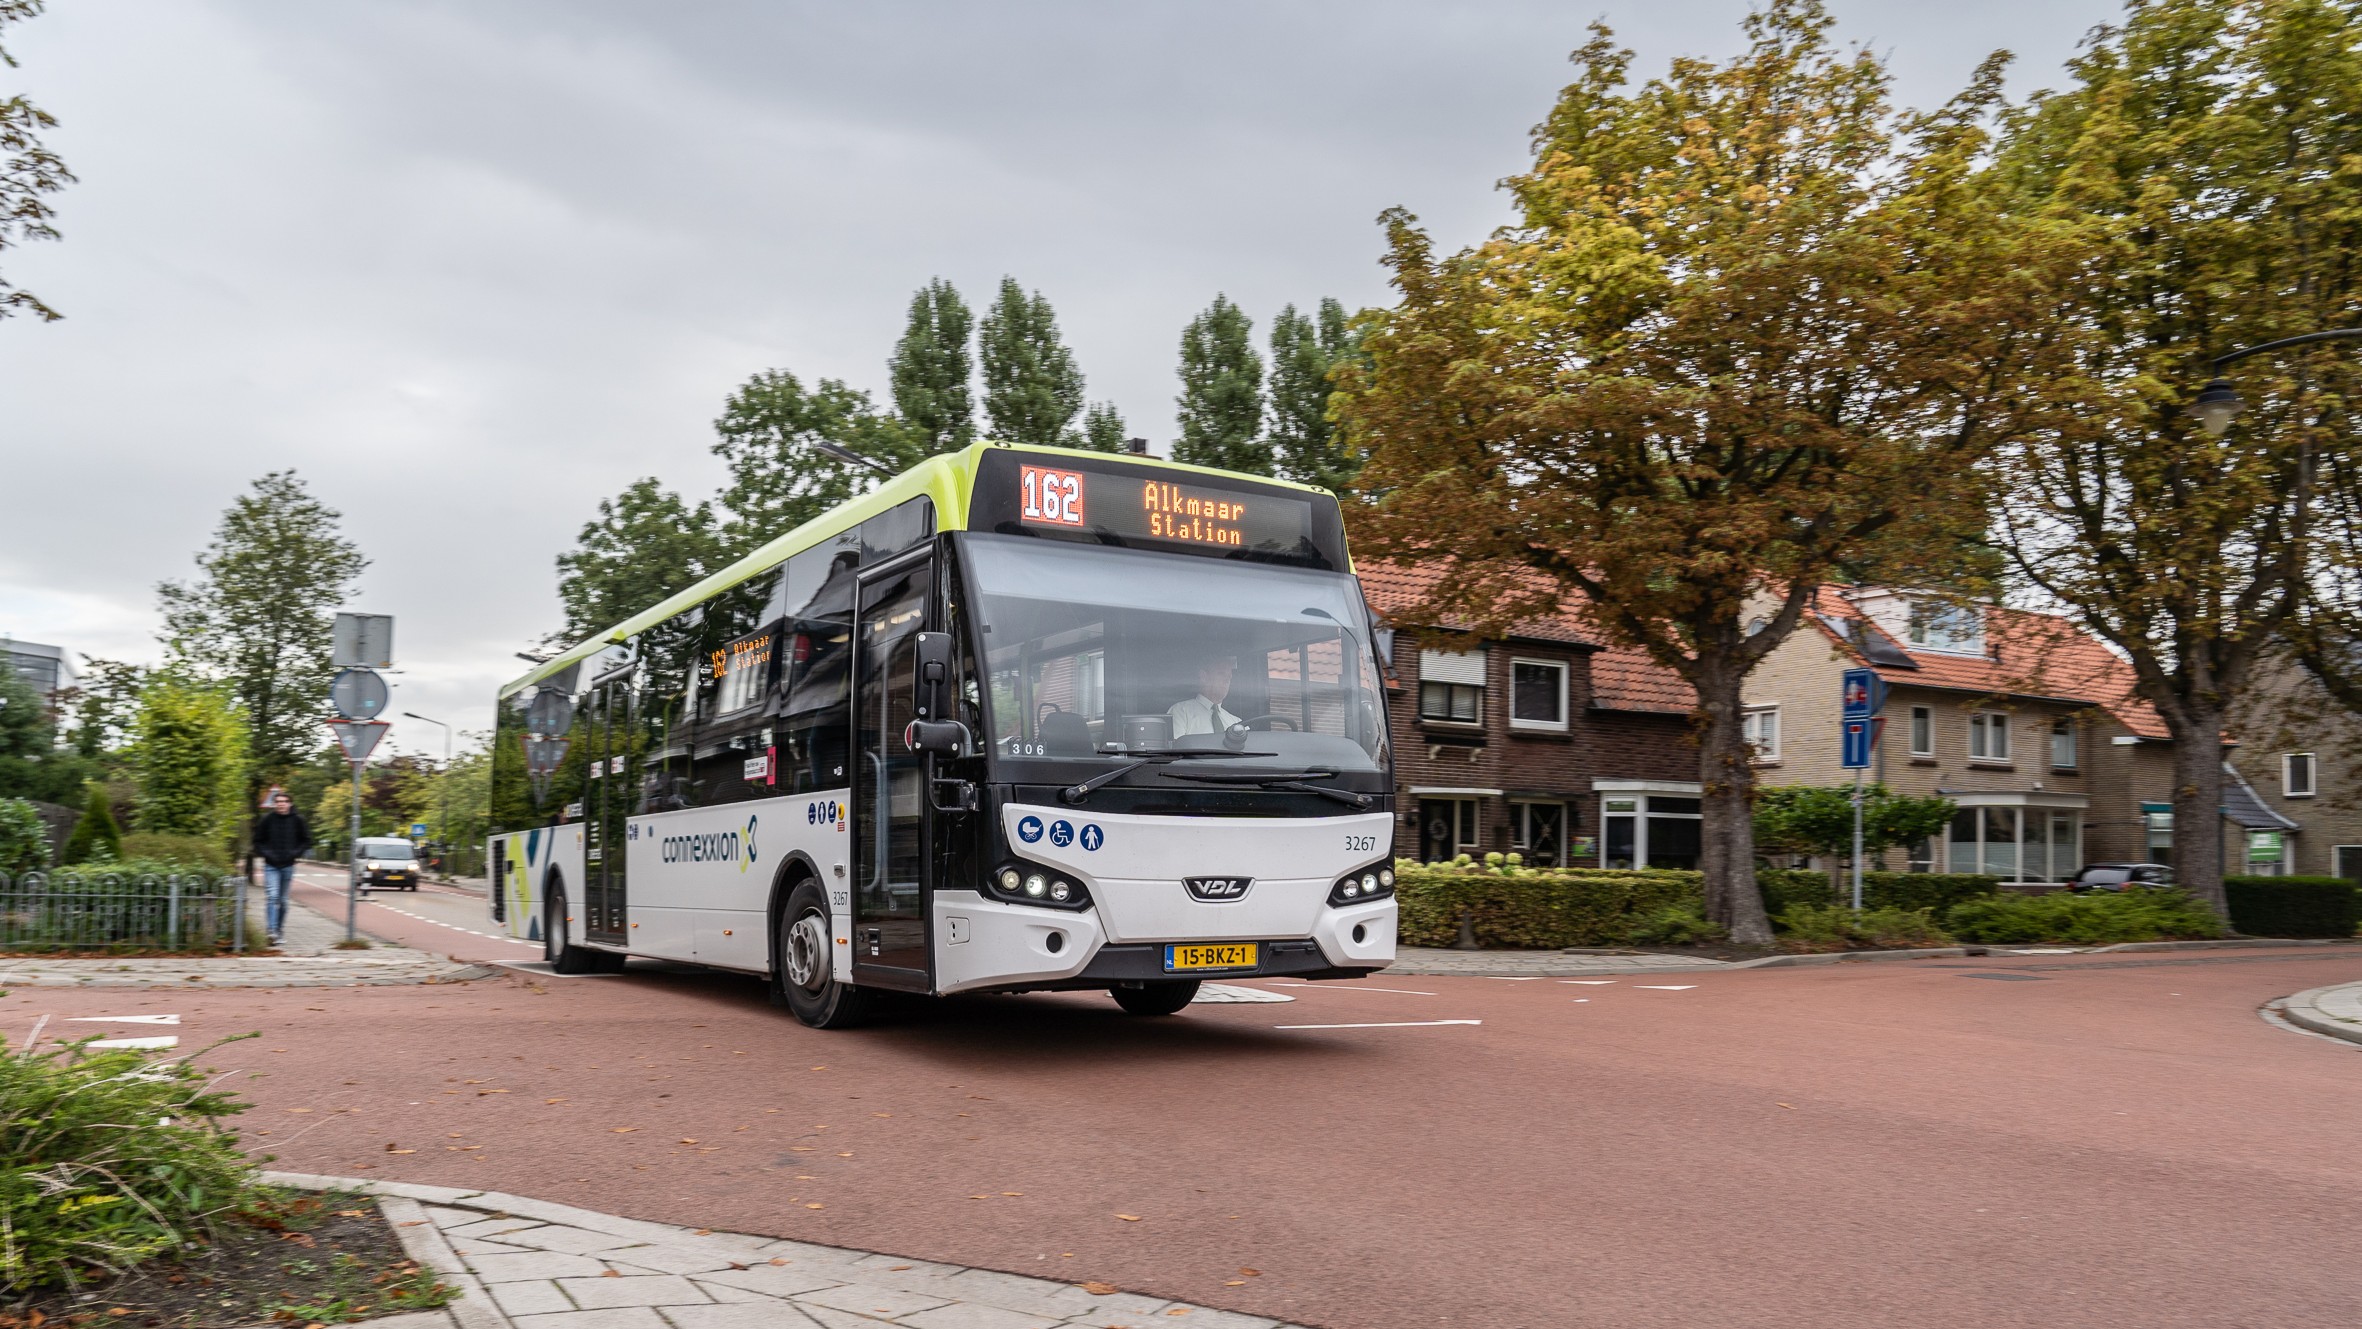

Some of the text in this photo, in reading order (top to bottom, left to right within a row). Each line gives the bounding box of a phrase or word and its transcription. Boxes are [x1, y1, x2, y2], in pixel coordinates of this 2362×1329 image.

[1024, 470, 1081, 522] 162
[1145, 482, 1244, 521] Alkmaar
[1151, 513, 1240, 545] Station
[733, 635, 769, 656] Alkmaar
[711, 648, 728, 678] 162
[663, 832, 738, 863] connexxion
[1345, 836, 1376, 851] 3267
[833, 891, 848, 906] 3267
[1195, 880, 1242, 895] VDL
[1183, 947, 1246, 965] 15-BKZ-1
